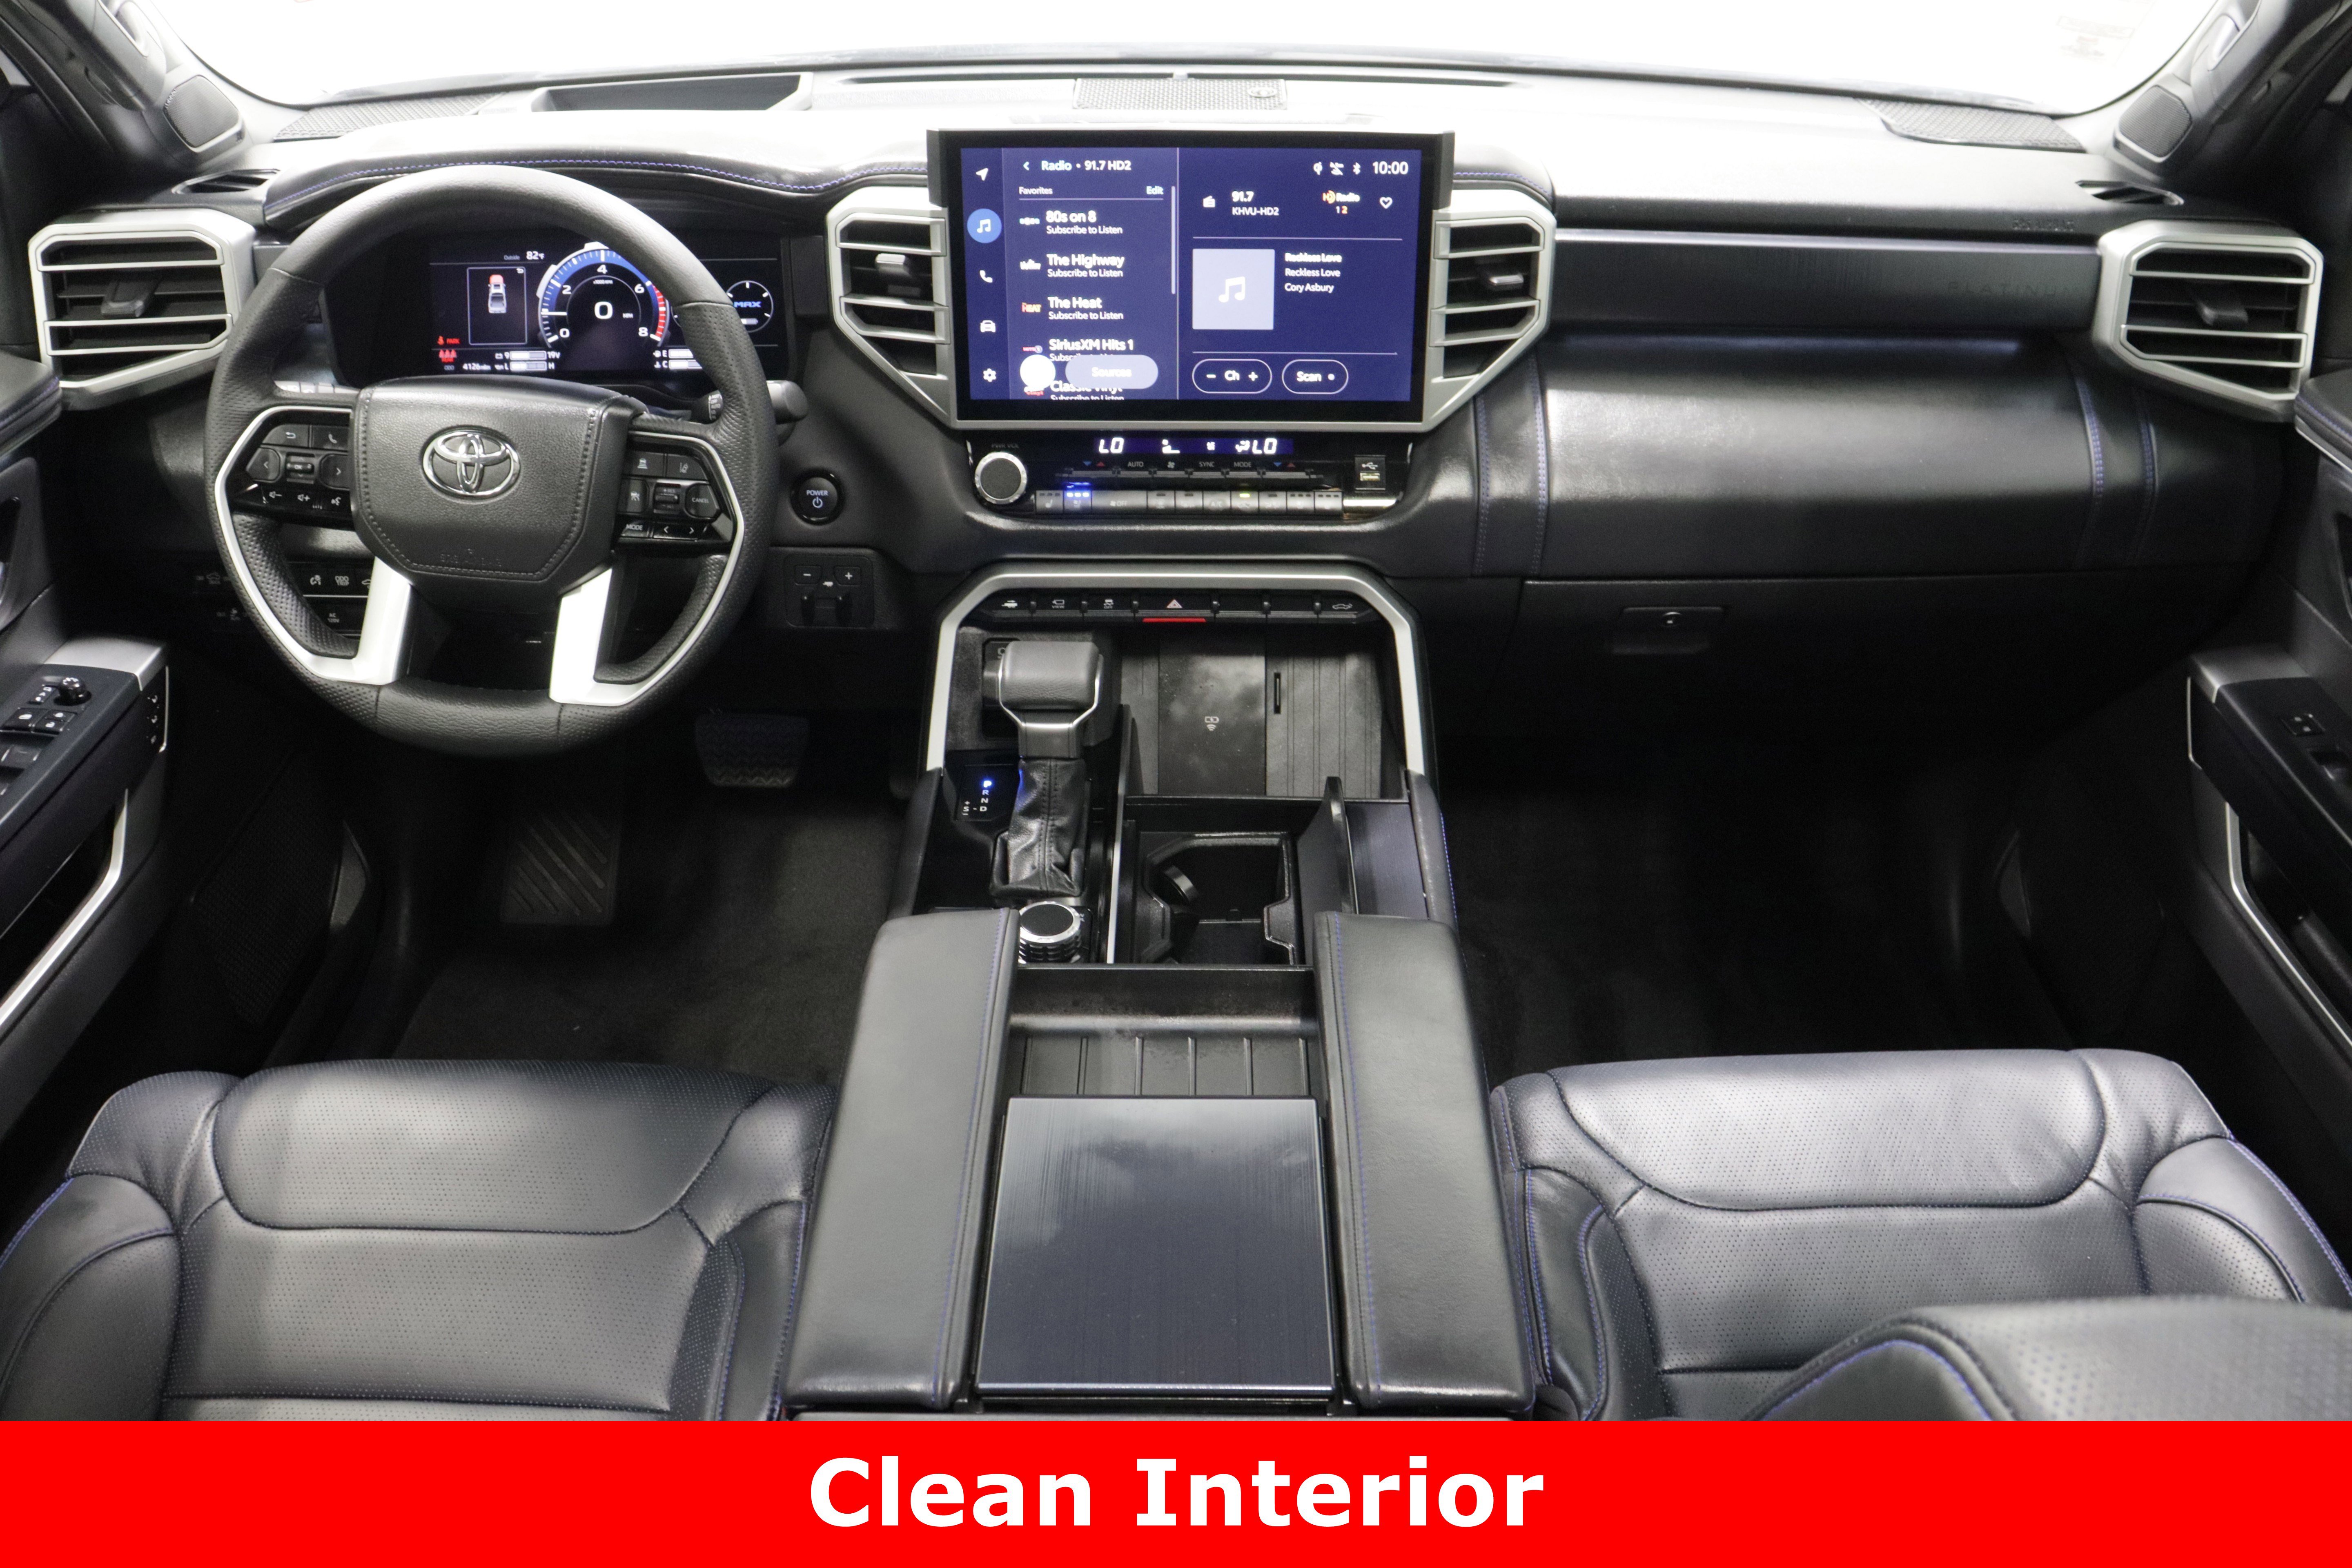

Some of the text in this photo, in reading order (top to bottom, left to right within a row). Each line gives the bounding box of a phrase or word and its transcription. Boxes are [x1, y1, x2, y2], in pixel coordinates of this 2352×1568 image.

[1041, 160, 1131, 171] Radio 91.7 HD2
[1372, 161, 1408, 174] 10:00
[1019, 185, 1164, 194] Favorites Edit
[1232, 191, 1254, 202] 91.7
[1336, 192, 1360, 202] Radio
[1232, 207, 1279, 216] KHVU-HD2
[1341, 205, 1348, 214] 2
[1046, 210, 1068, 223] 80s
[1069, 212, 1086, 223] on
[1088, 210, 1097, 223] 8
[1046, 225, 1123, 234] Subscribe to Listen
[1047, 254, 1070, 266] The
[1071, 254, 1125, 269] Highway
[1285, 252, 1343, 262] Reckless Love
[597, 265, 608, 274] 4
[1047, 269, 1088, 277] Subscribe
[1099, 269, 1124, 277] Listen
[1285, 267, 1341, 277] Reckless Love
[561, 285, 572, 294] 2
[634, 283, 645, 294] 6
[1285, 282, 1334, 293] Cory Asbury
[1947, 281, 2079, 297] PLATINUM
[1047, 296, 1102, 309] The Heat
[594, 301, 613, 319] 0
[1049, 311, 1088, 319] Subscribe
[1099, 311, 1124, 319] Listen
[559, 328, 570, 338] 0
[638, 327, 648, 337] 8
[1049, 339, 1134, 351] SiriusXM Hits 1
[1091, 367, 1132, 377] Sources
[1225, 370, 1240, 381] Ch
[1296, 371, 1322, 381] Scan
[1098, 437, 1125, 454] LO
[1252, 438, 1277, 454] LO
